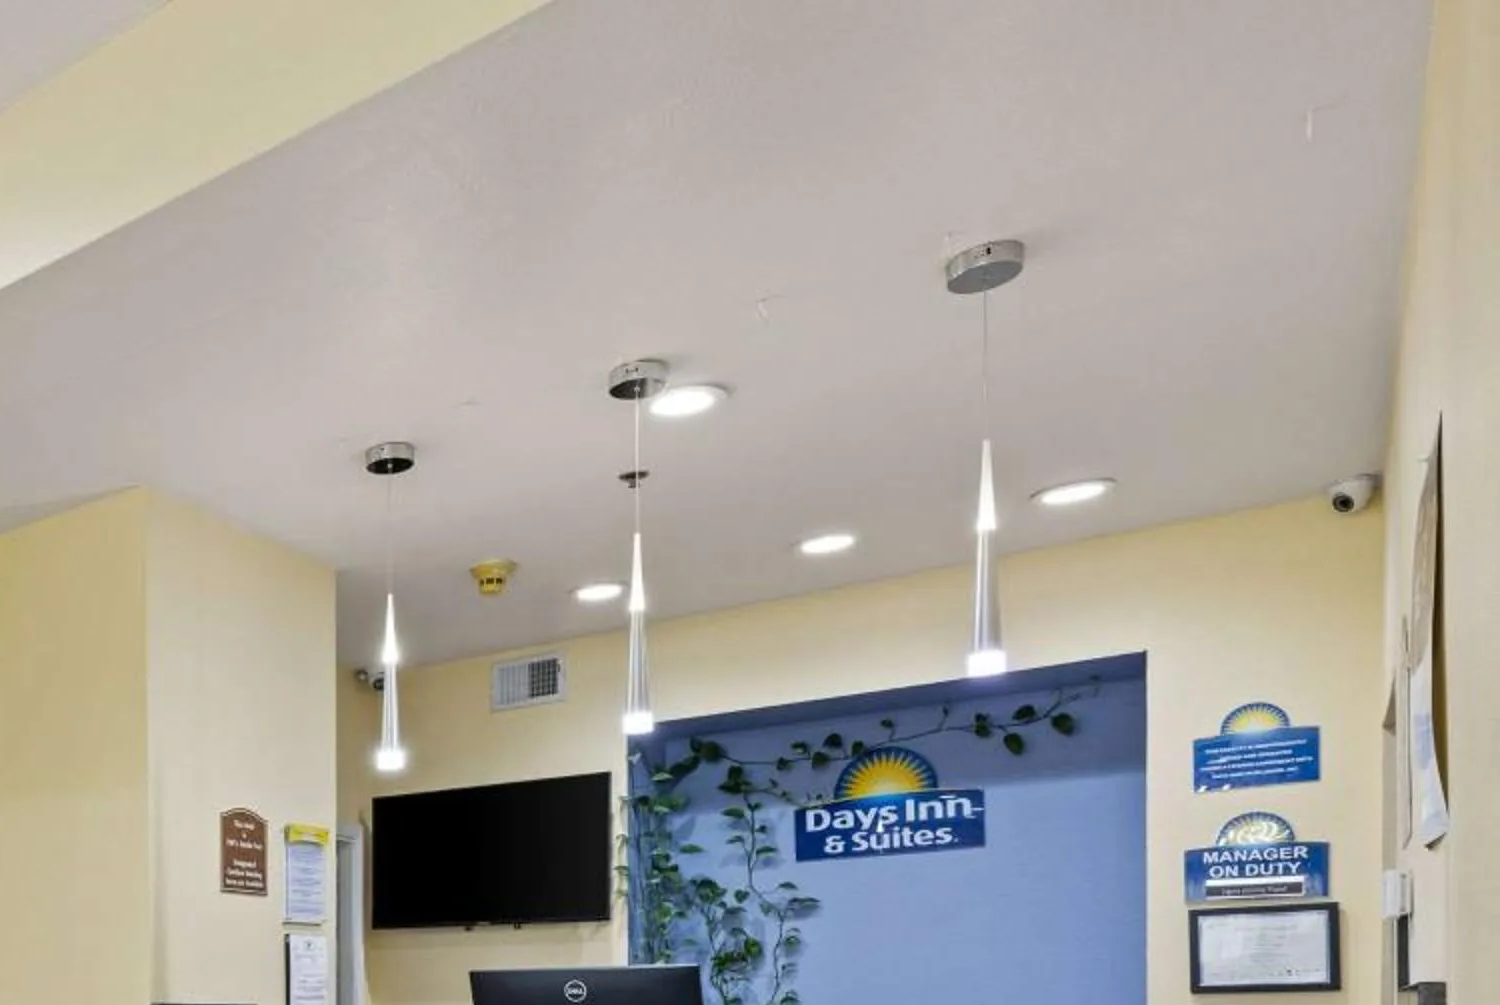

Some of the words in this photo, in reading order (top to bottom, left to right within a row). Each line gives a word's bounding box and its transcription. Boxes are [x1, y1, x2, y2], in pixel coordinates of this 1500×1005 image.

[805, 805, 899, 833] Days
[905, 796, 972, 822] Inn
[823, 835, 846, 854] &
[1203, 845, 1309, 864] MANAGER
[1209, 865, 1239, 878] ON
[1245, 861, 1301, 877] DUTY
